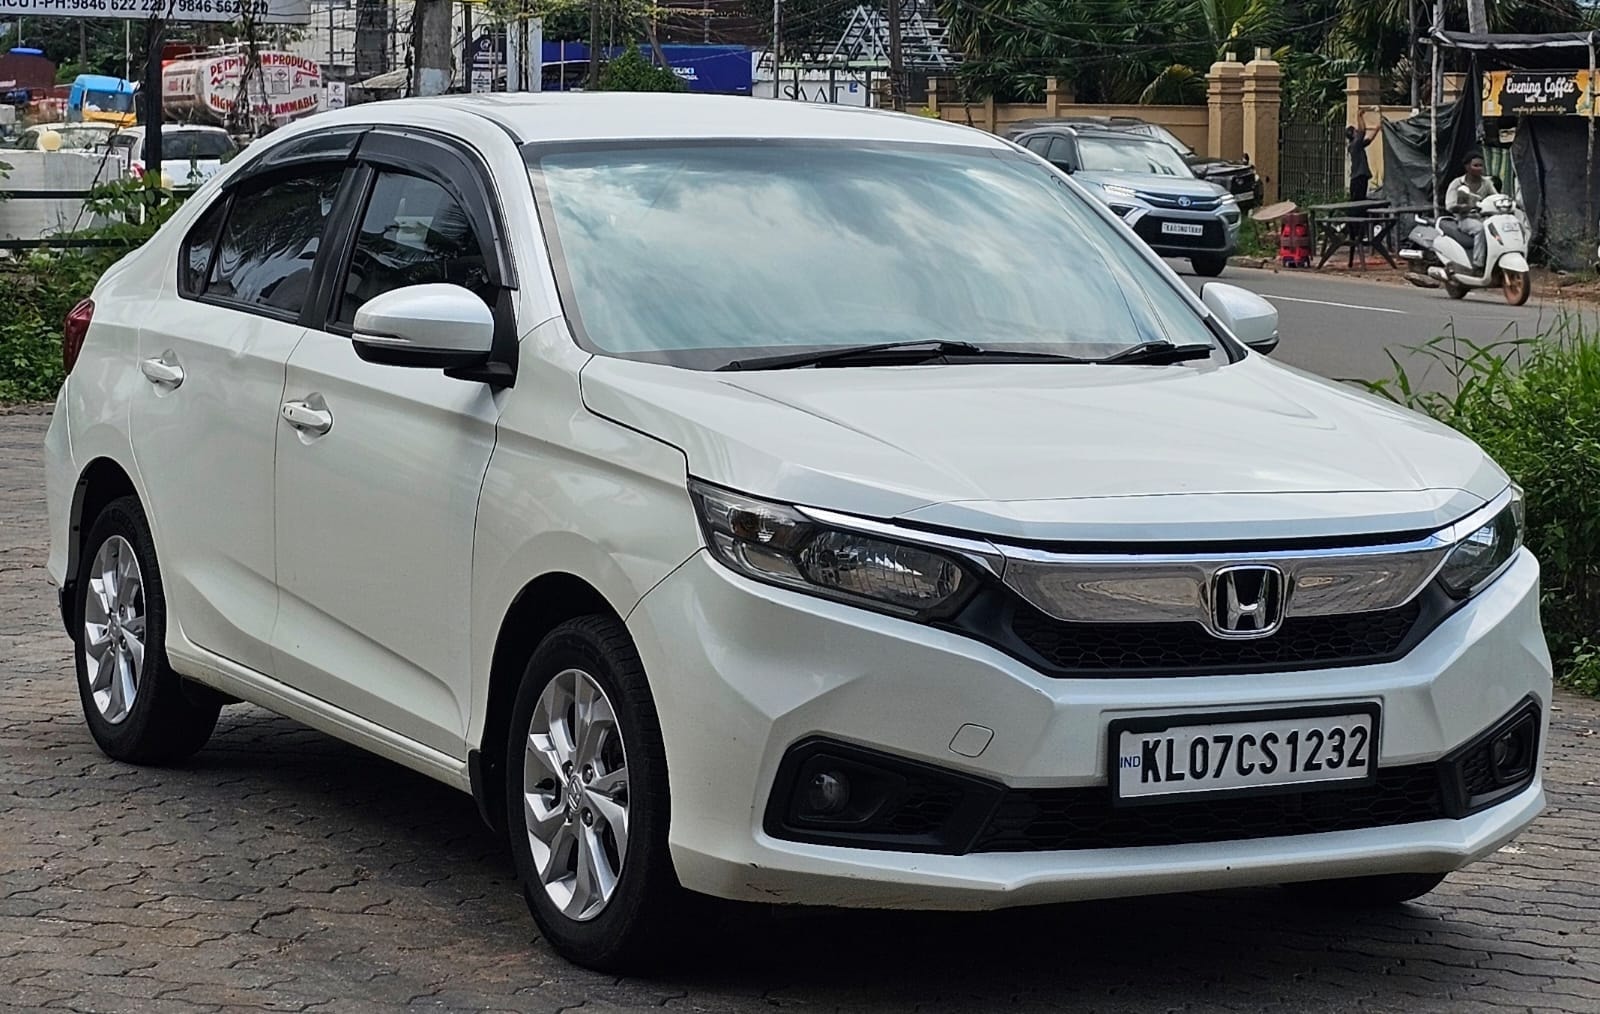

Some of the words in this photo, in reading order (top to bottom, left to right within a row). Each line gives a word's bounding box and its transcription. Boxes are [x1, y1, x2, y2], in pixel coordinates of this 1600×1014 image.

[0, 0, 106, 10] ICUT-PH:9846
[111, 0, 136, 10] 622
[179, 0, 211, 12] 9846
[216, 1, 240, 13] 562
[273, 54, 317, 74] PRODUCTS
[1506, 77, 1541, 98] Evening
[1544, 77, 1574, 98] Coffee
[1120, 755, 1141, 768] IND
[1141, 725, 1368, 783] KL07CS1232
